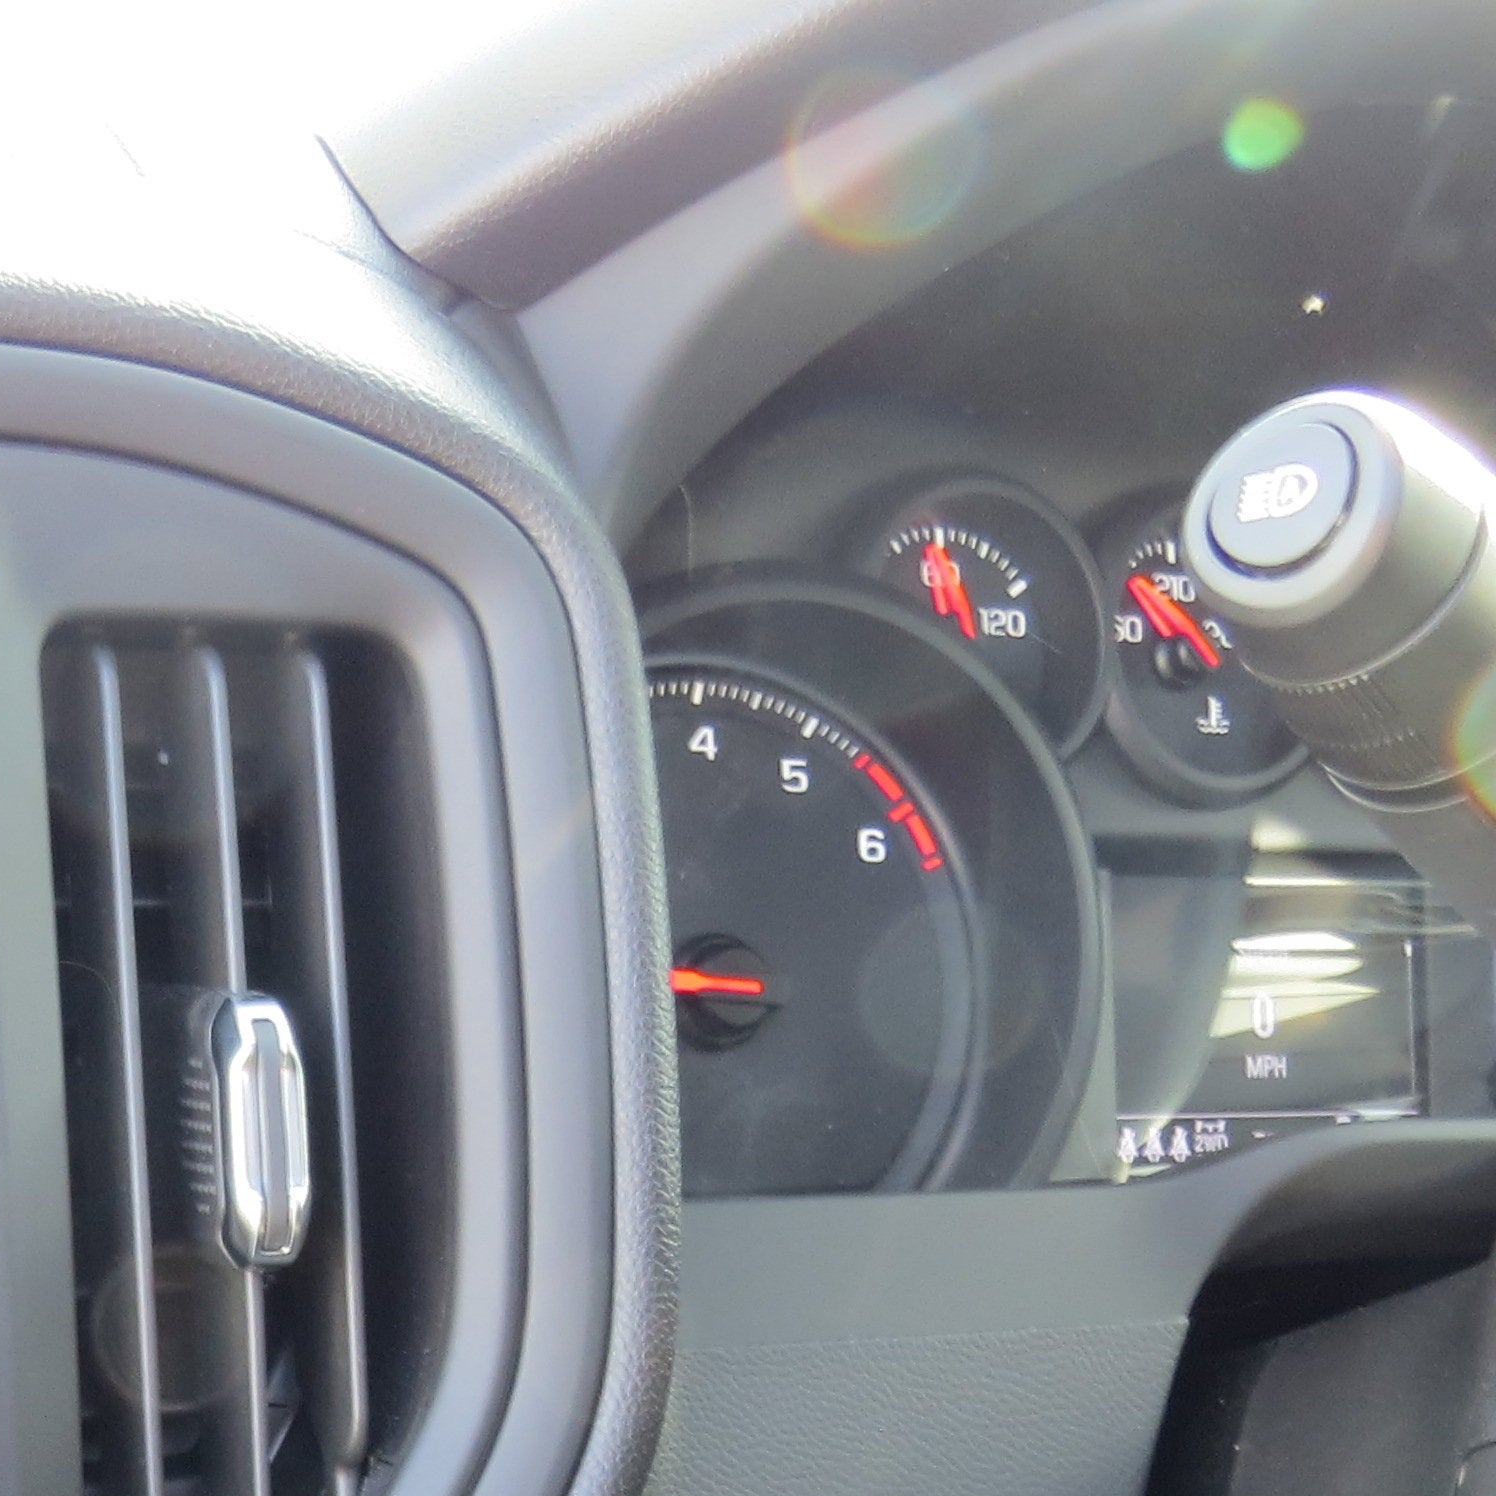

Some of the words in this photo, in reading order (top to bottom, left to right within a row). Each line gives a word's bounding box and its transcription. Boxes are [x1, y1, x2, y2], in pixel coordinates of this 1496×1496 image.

[1153, 572, 1195, 602] 210
[978, 607, 1027, 638] 120
[688, 724, 718, 761] 4
[779, 758, 809, 793] 5
[857, 827, 887, 863] 6
[1253, 989, 1276, 1039] 0
[1244, 1054, 1287, 1079] MPH
